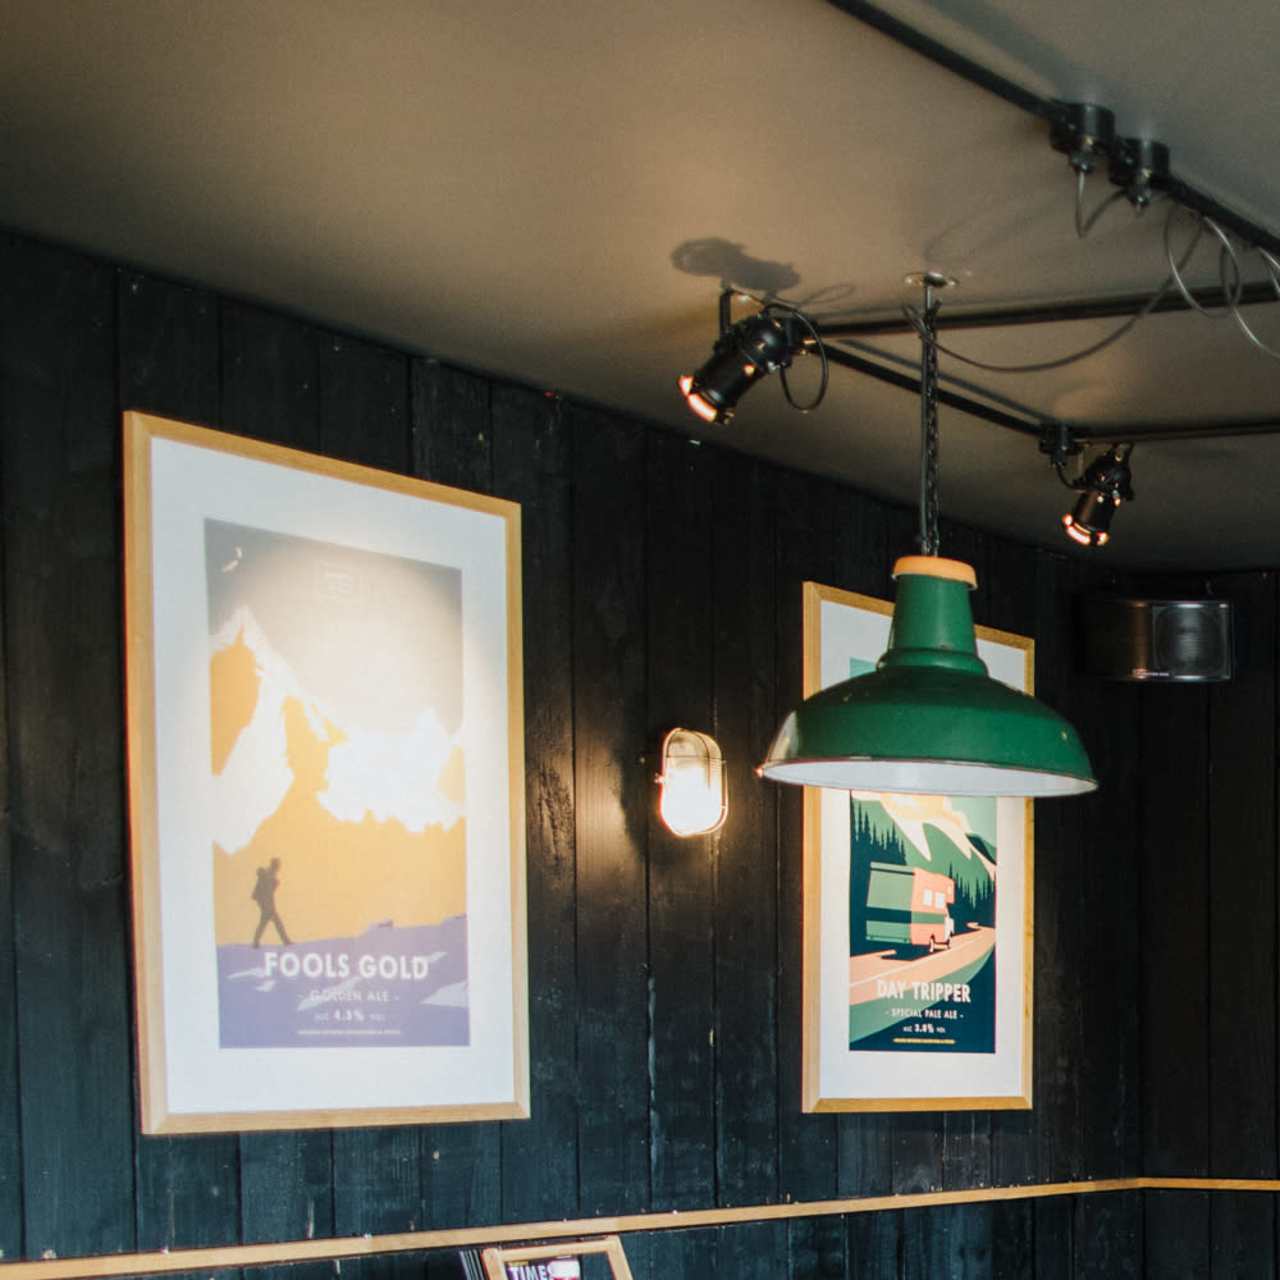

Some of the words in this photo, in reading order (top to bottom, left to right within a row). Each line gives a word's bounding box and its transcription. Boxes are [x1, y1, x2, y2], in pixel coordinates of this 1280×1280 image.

[264, 952, 350, 978] FOOLS
[359, 954, 429, 980] GOLD
[876, 979, 906, 998] DAY
[912, 981, 971, 1003] TRIPPER
[924, 1009, 941, 1019] PALE
[944, 1009, 958, 1019] ALE
